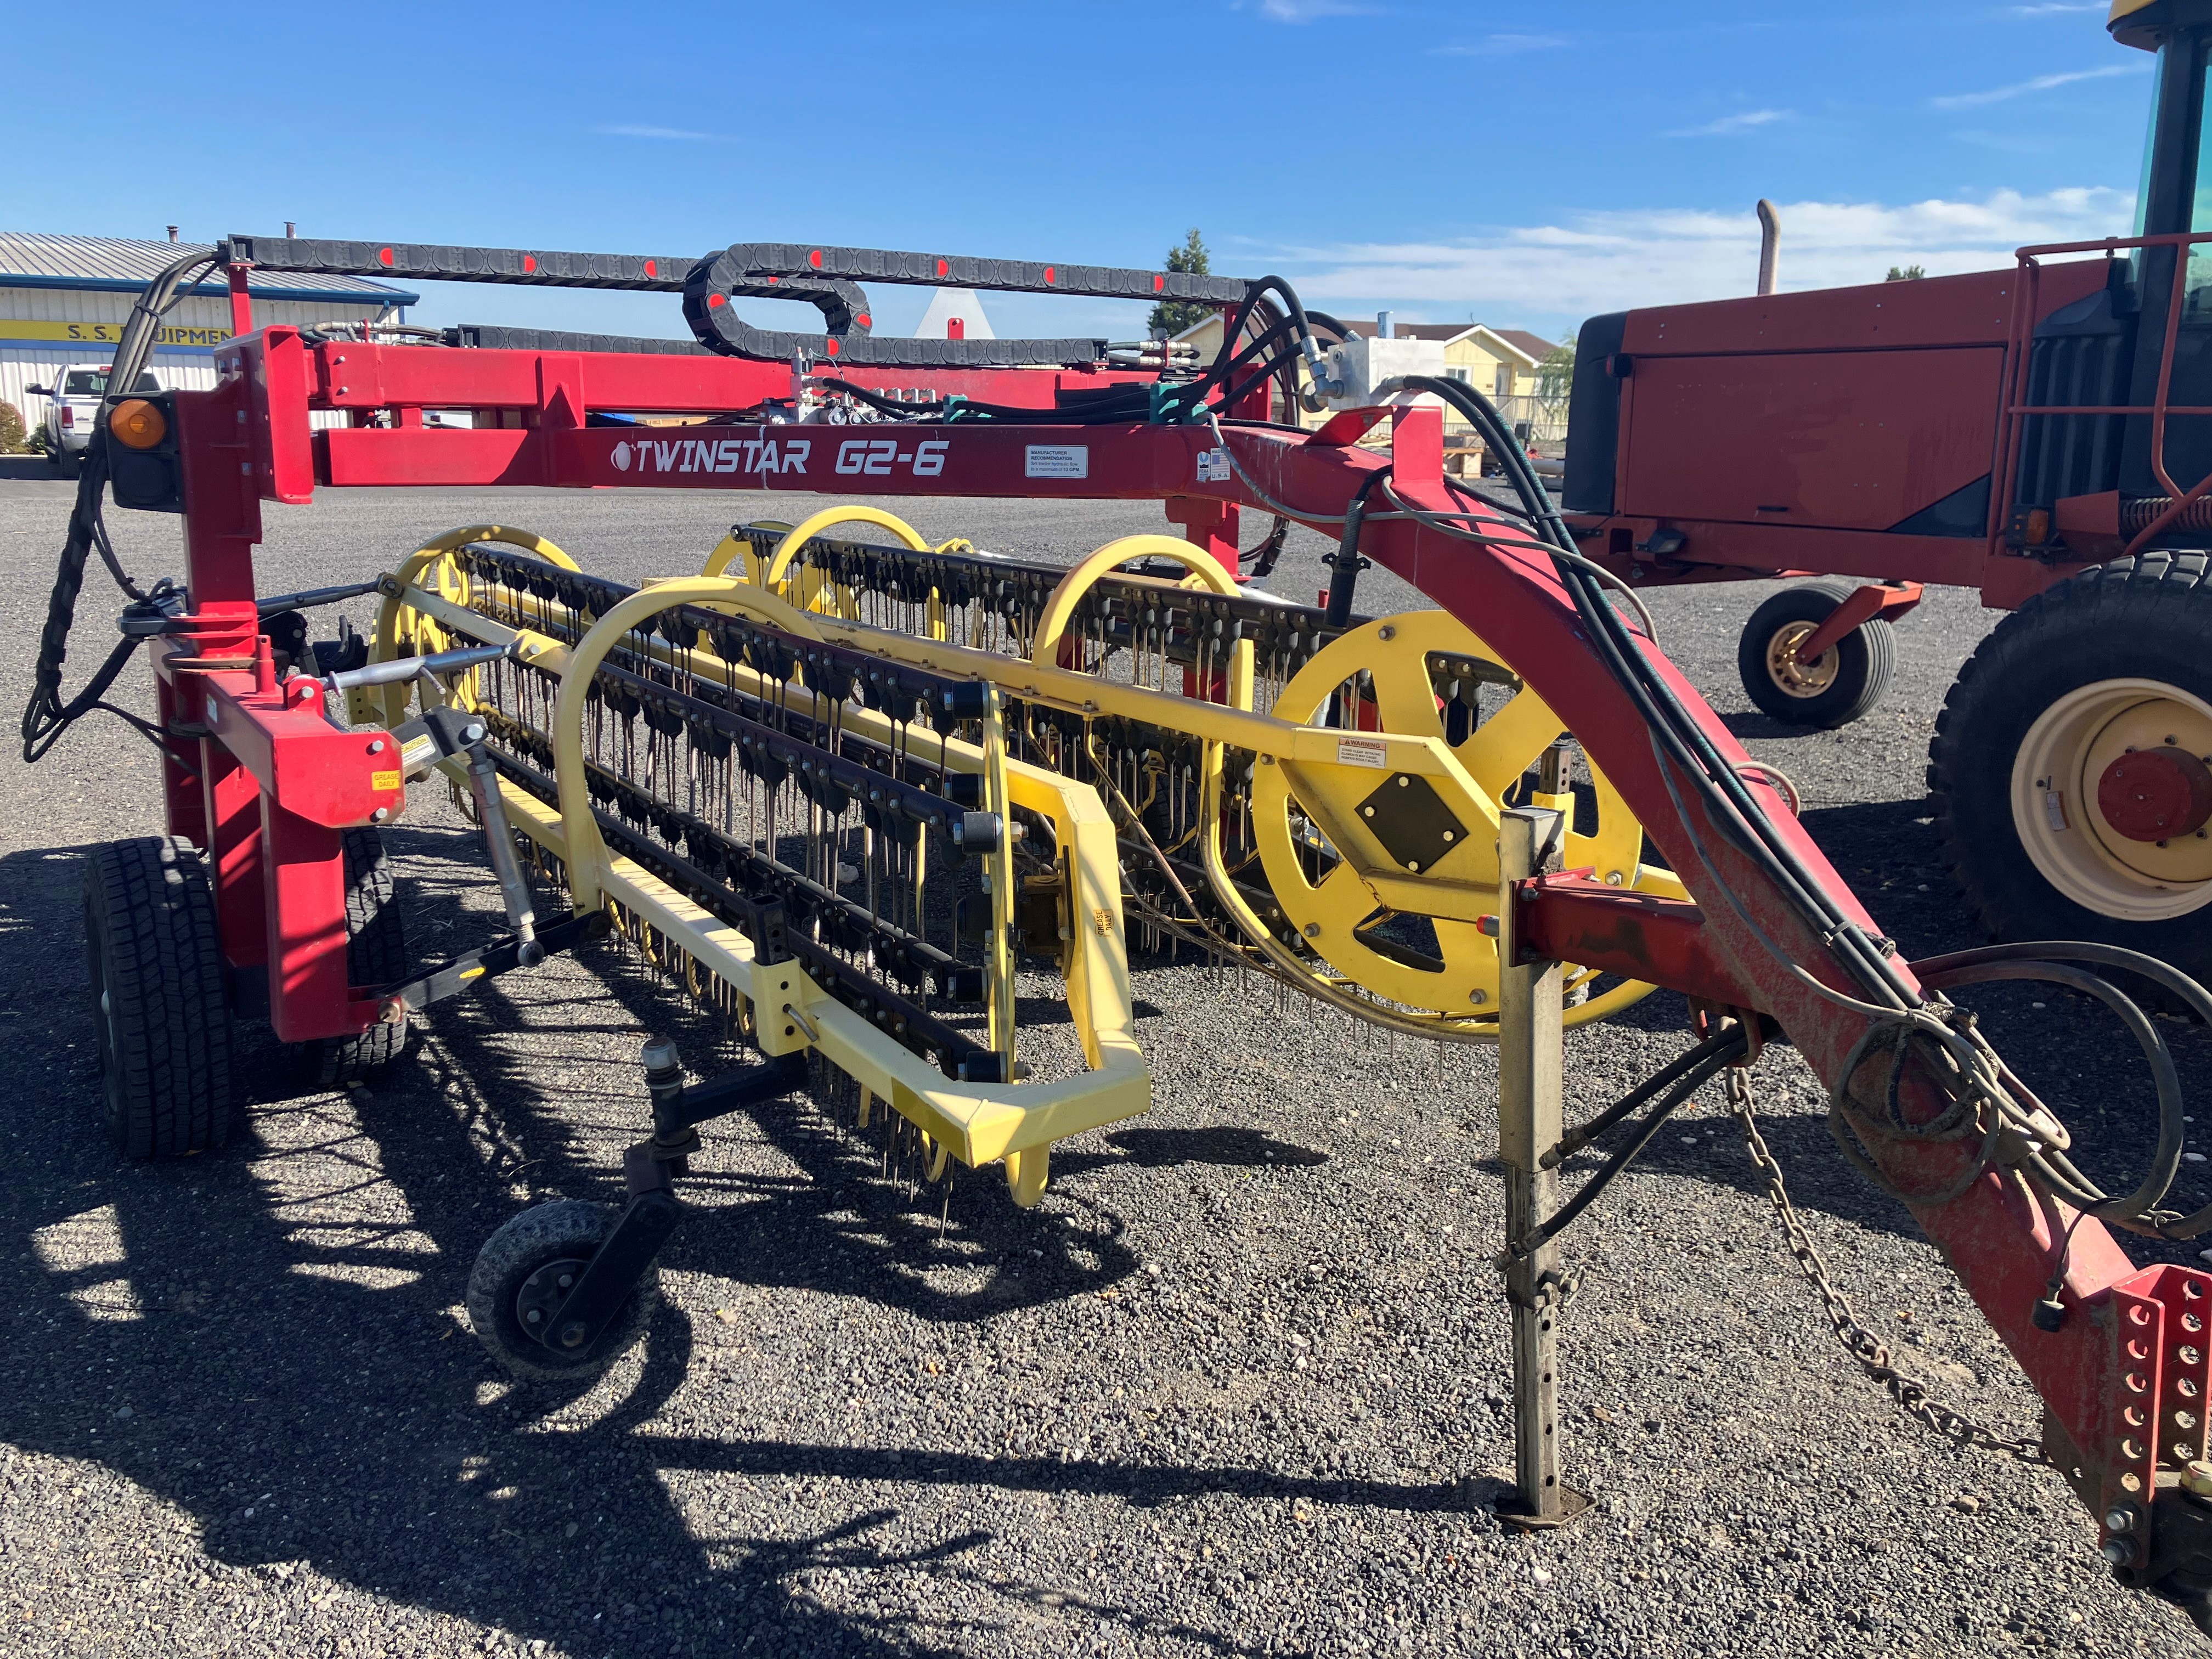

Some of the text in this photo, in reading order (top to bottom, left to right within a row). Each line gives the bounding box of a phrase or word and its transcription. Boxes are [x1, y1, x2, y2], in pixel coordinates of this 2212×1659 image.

[68, 324, 233, 344] S. S. UIPMEN
[636, 440, 950, 476] TWINSTAR G2-6
[1350, 740, 1380, 748] WARNING
